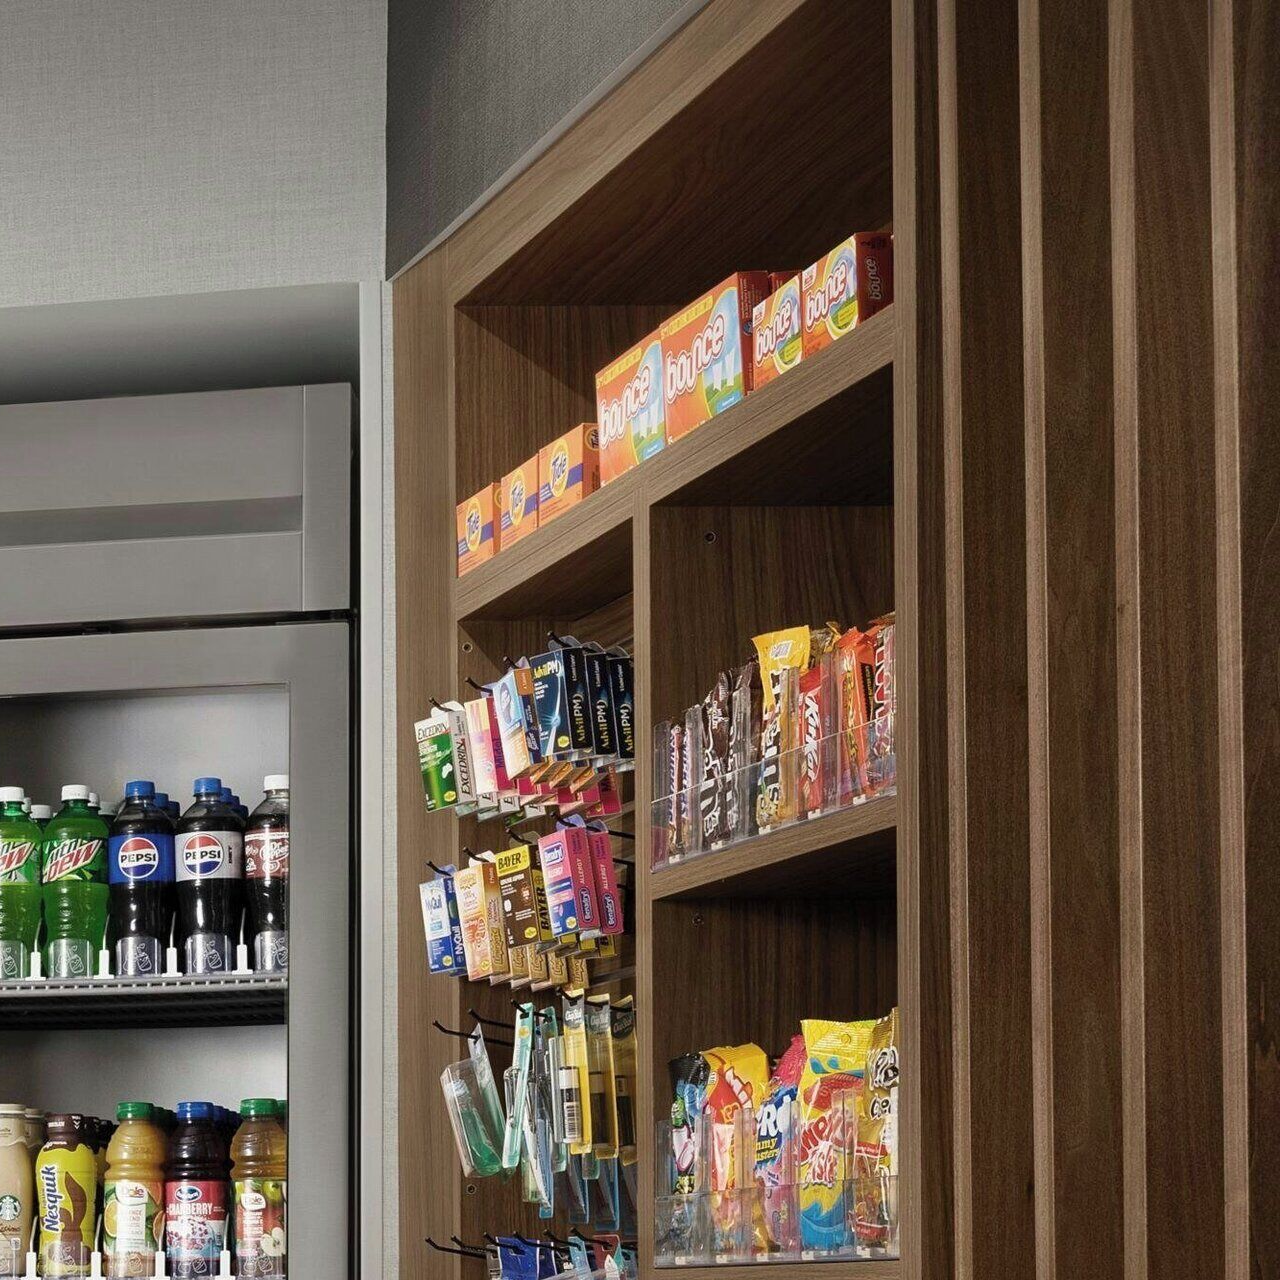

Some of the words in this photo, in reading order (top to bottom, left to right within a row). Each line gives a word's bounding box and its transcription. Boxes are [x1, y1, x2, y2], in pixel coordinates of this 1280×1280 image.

[807, 261, 847, 332] bounce
[866, 257, 881, 300] bounce
[755, 299, 791, 367] bounce
[666, 313, 725, 404] bounce
[599, 364, 650, 449] bounce
[418, 724, 447, 740] EXCEDRIN
[456, 738, 471, 795] EXCEDRIN
[120, 852, 156, 863] PEPSI
[185, 851, 221, 862] PEPSI
[498, 853, 521, 869] BAYER
[44, 1165, 61, 1233] Nesquik
[169, 1203, 213, 1215] CRANBERRY
